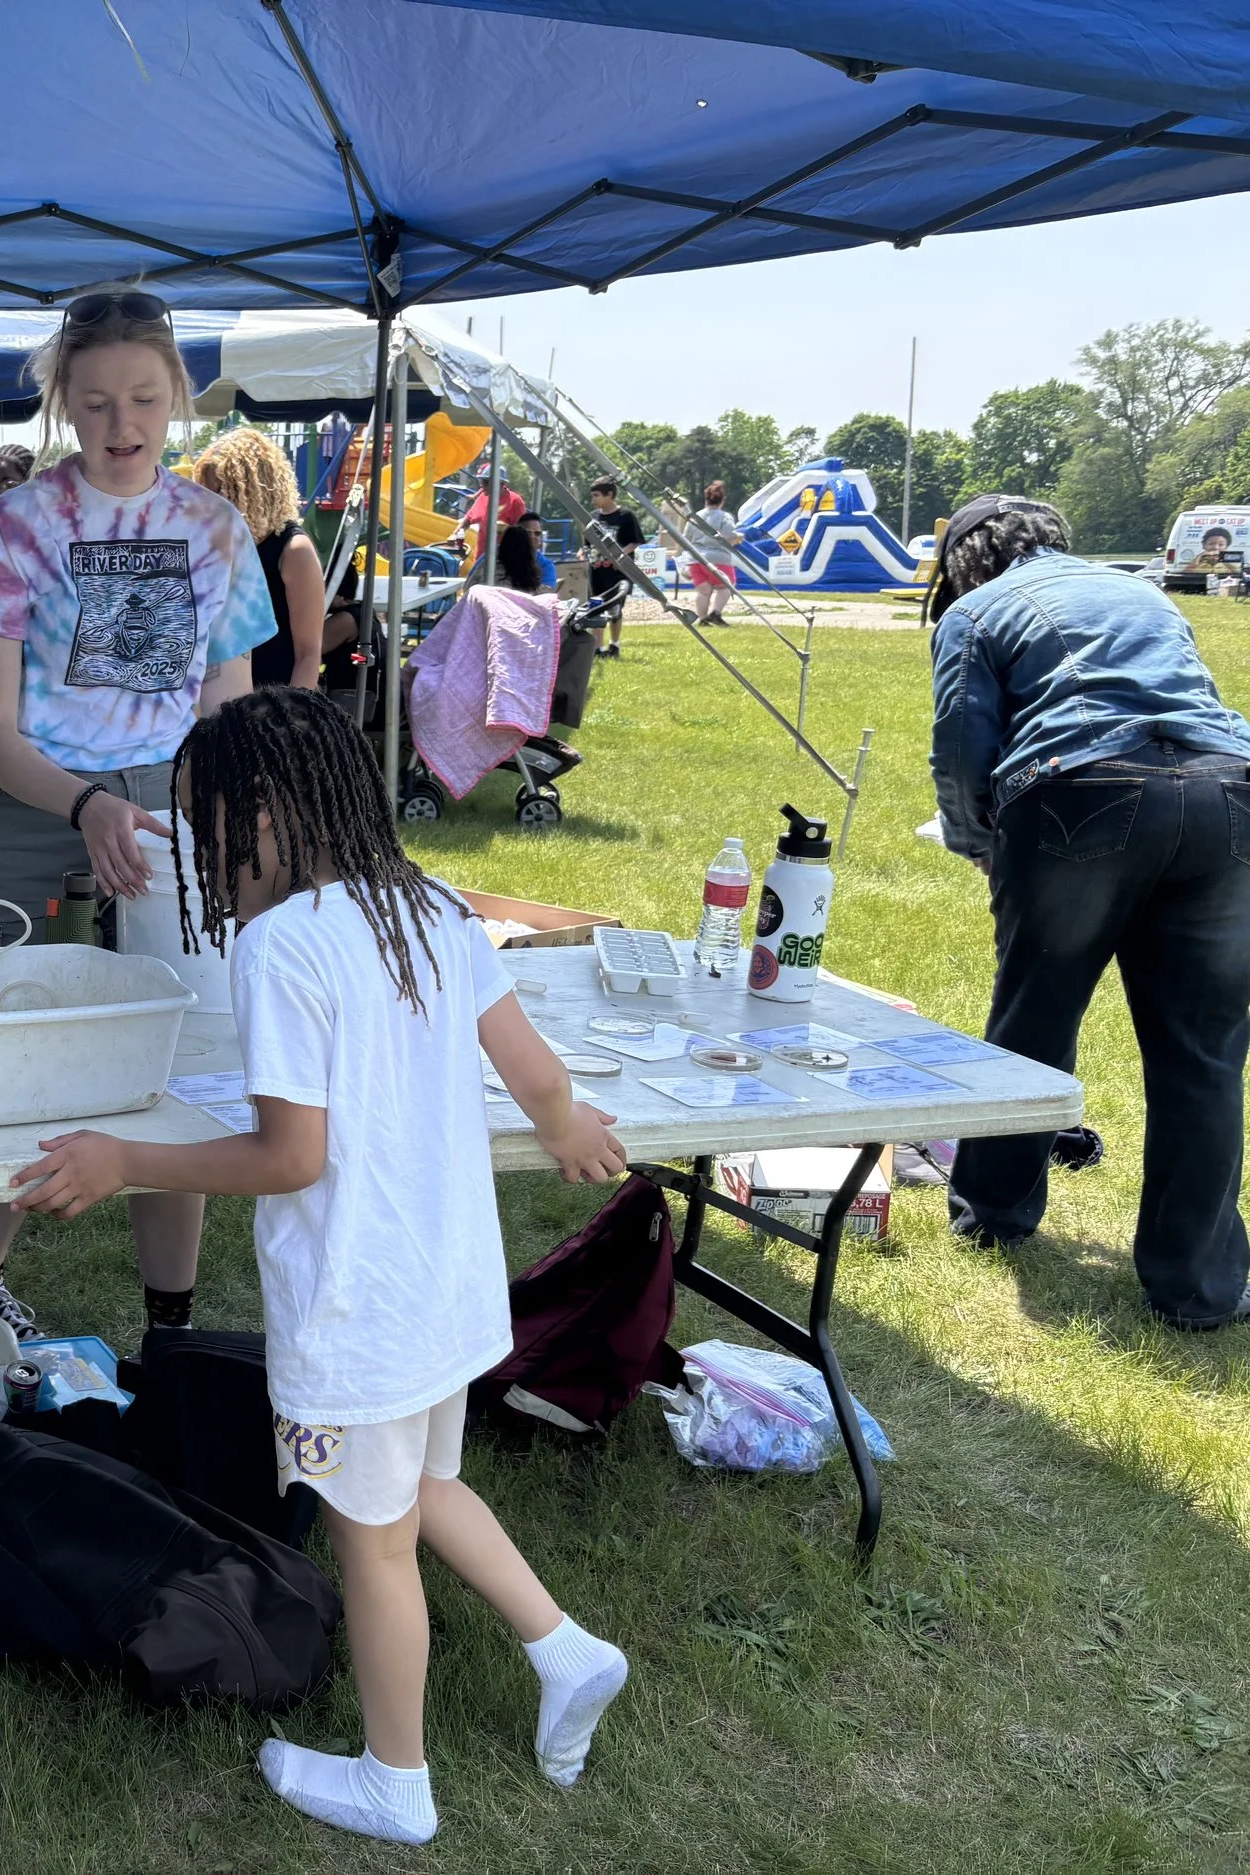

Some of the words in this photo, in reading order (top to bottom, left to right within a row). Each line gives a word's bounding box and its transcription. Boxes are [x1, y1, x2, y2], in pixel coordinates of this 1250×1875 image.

[81, 555, 131, 573] RIVER
[133, 553, 164, 571] DAY
[140, 661, 177, 678] 2025
[875, 1199, 884, 1208] L
